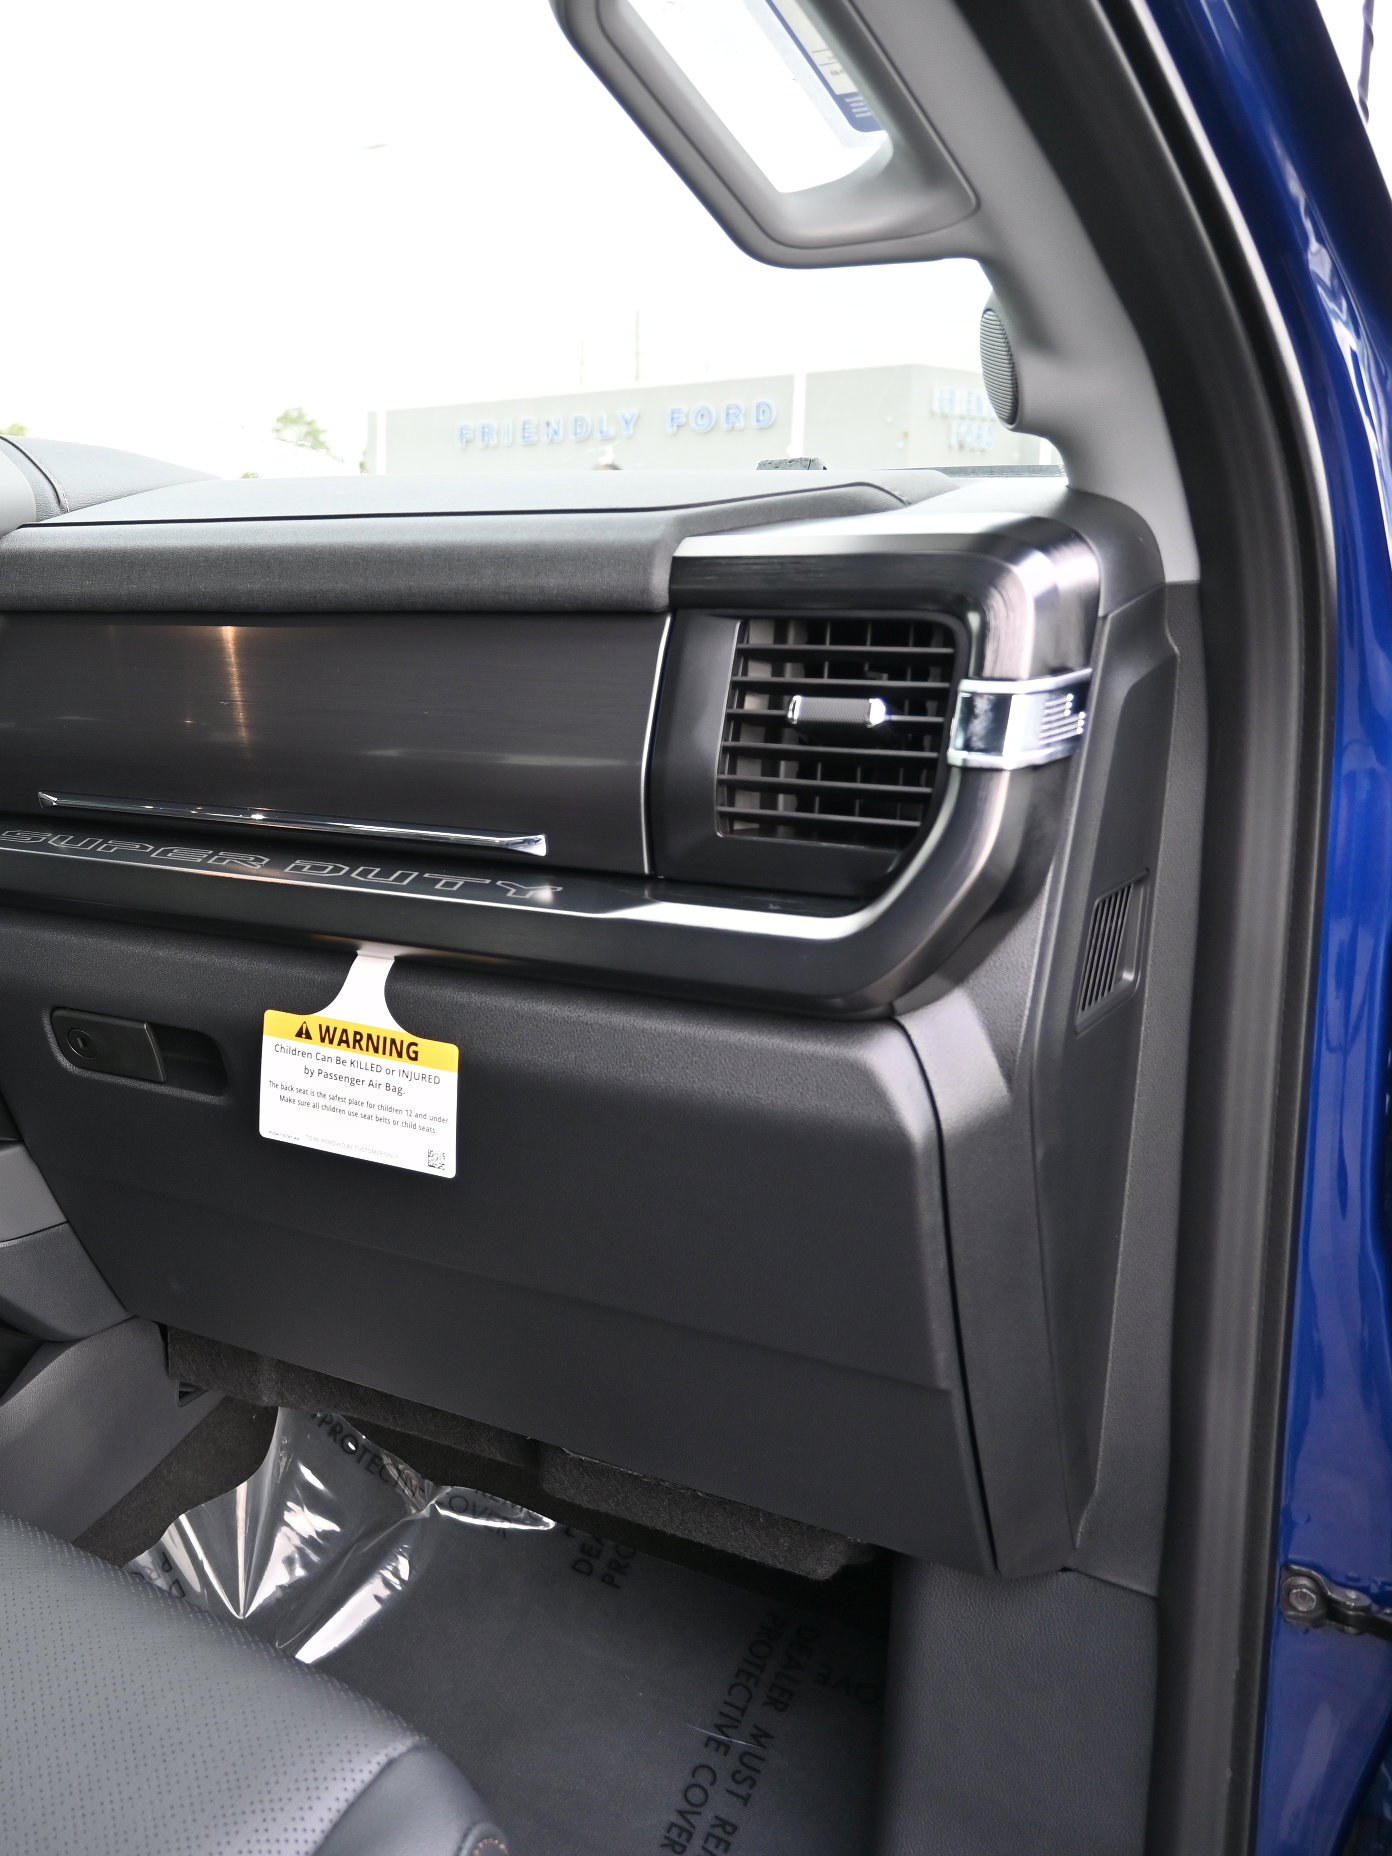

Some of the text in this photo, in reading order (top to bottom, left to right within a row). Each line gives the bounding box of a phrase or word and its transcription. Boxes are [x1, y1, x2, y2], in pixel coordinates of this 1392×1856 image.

[459, 399, 775, 448] FRIENDLY FORD
[284, 859, 563, 899] DUTY
[318, 1023, 419, 1061] WARNING
[274, 1043, 441, 1085] Children Can Be KILLED or INJURED
[304, 1065, 406, 1097] by Passenger Air Bag.
[269, 1080, 279, 1089] The
[280, 1082, 295, 1092] back
[295, 1087, 309, 1095] seat
[309, 1088, 315, 1097] is
[316, 1091, 327, 1099] the
[328, 1094, 347, 1103] safest
[348, 1097, 364, 1107] place
[366, 1100, 375, 1110] for
[377, 1103, 403, 1115] children
[405, 1109, 413, 1117] 12
[414, 1112, 427, 1120] and
[279, 1094, 296, 1105] Make
[297, 1099, 311, 1107] sure
[311, 1102, 320, 1110] all
[321, 1104, 346, 1115] children
[347, 1110, 359, 1118] use
[360, 1112, 374, 1121] seat
[375, 1115, 391, 1125] belts
[401, 1120, 417, 1130] child
[761, 1624, 821, 1713] DEALER
[660, 1609, 788, 1855] PROTECTIVE COVER
[724, 1723, 775, 1807] MUST
